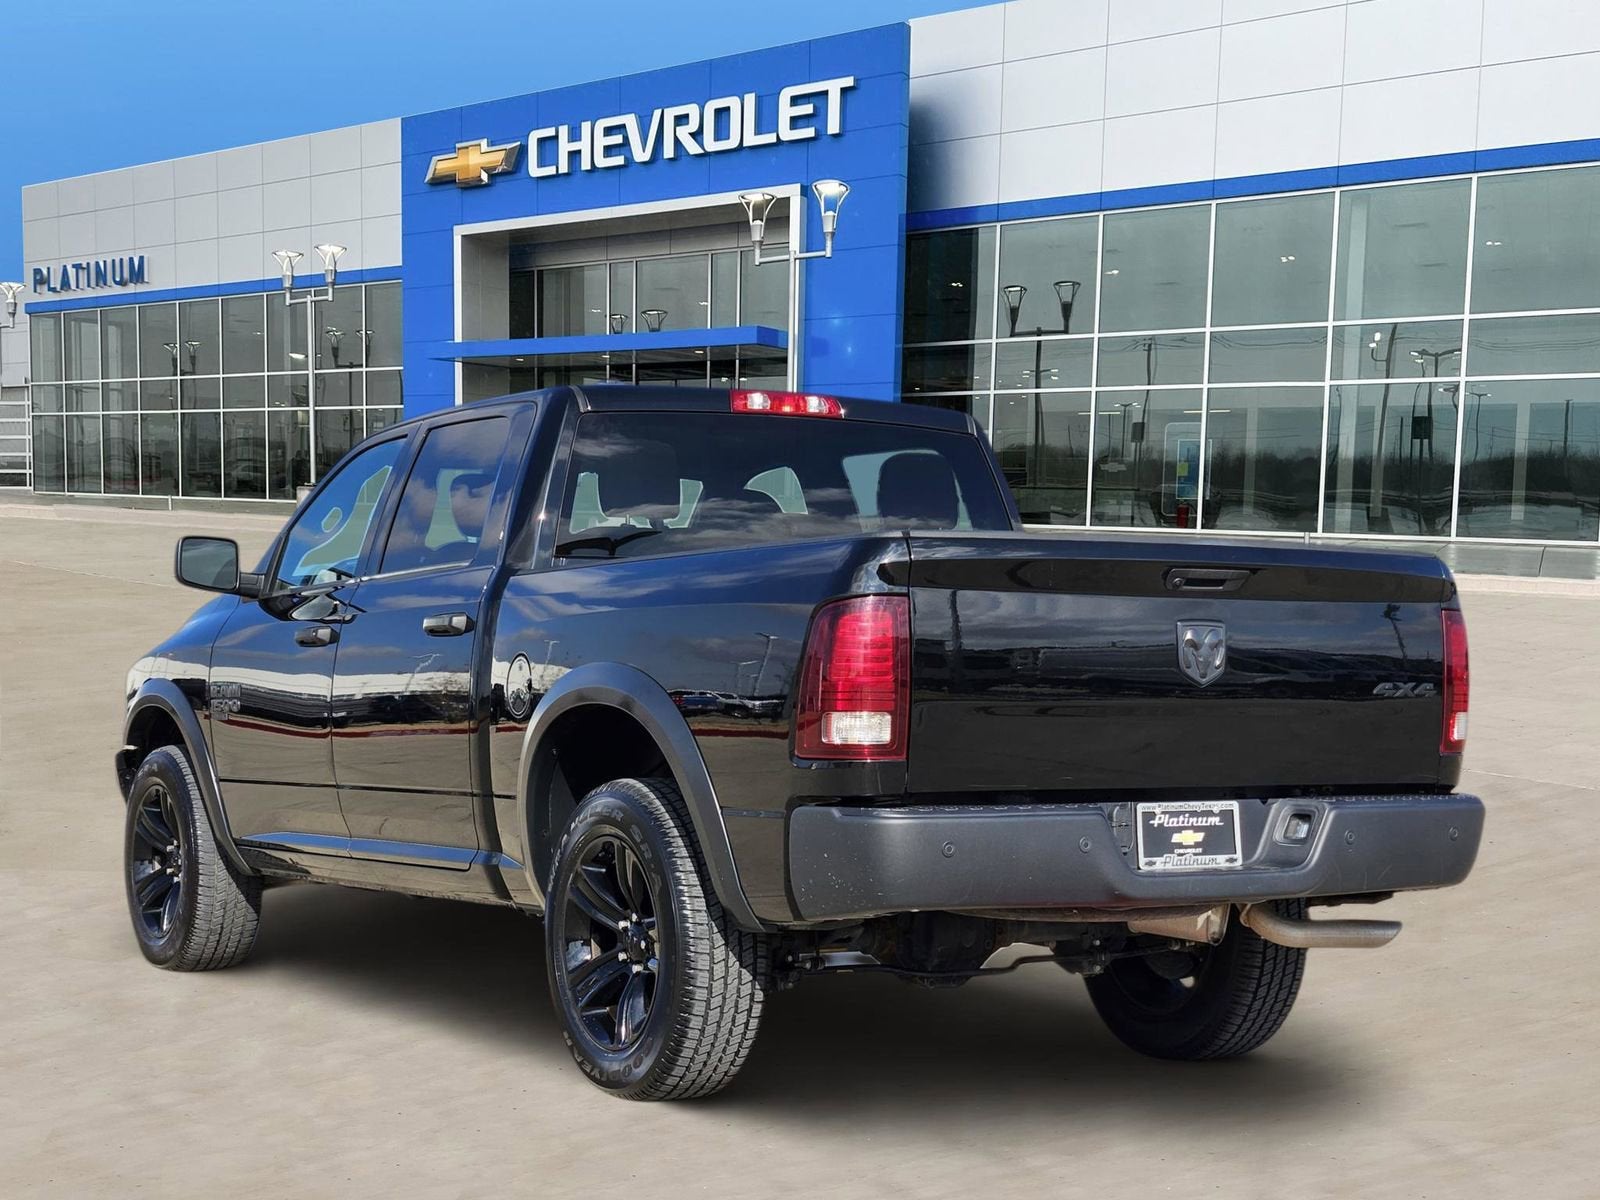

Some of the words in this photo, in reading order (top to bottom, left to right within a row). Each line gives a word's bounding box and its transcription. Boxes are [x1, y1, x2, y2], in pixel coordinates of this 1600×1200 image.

[527, 76, 856, 179] CHEVROLET
[33, 255, 147, 294] PLATINUM
[1149, 814, 1224, 827] Platinum
[1160, 855, 1221, 867] Platinum
